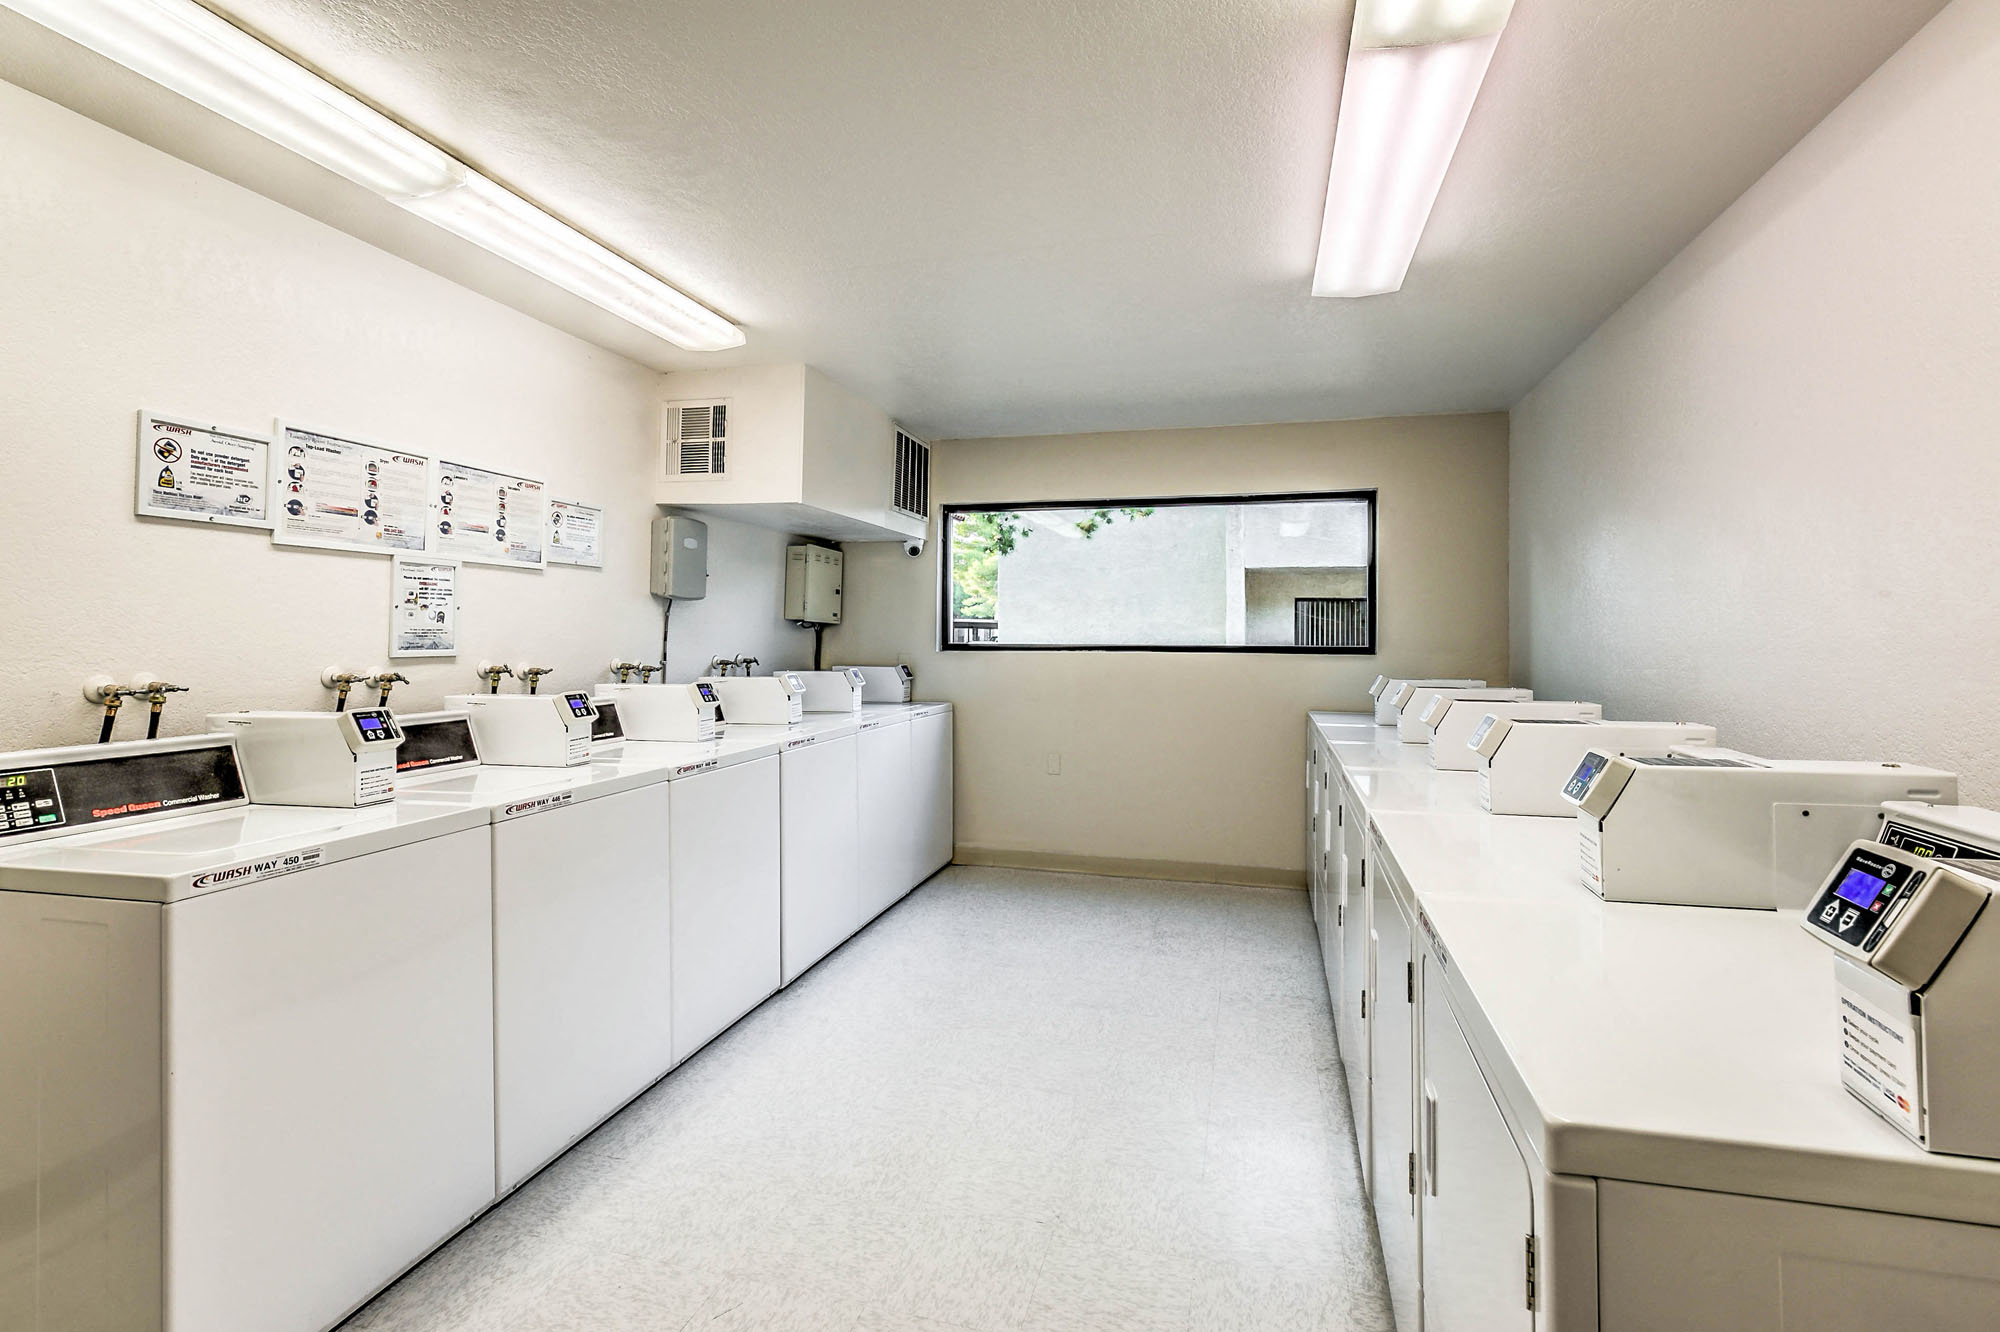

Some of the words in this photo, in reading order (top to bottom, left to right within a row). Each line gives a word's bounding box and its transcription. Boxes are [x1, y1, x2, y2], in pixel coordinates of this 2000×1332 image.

[166, 425, 192, 436] WASH
[305, 443, 325, 451] Top-Load
[402, 456, 424, 466] WASH
[8, 775, 25, 787] 20
[92, 805, 128, 818] Speed
[127, 801, 161, 812] Queen
[162, 795, 198, 806] Commercial
[198, 792, 220, 801] Washer
[515, 800, 536, 811] WASH
[536, 798, 550, 806] WAY
[212, 865, 252, 882] WASH
[254, 860, 278, 873] WAY
[282, 855, 300, 867] 450
[1841, 996, 1866, 1018] OPERATION
[1867, 1011, 1905, 1044] INSTRUCTIONS
